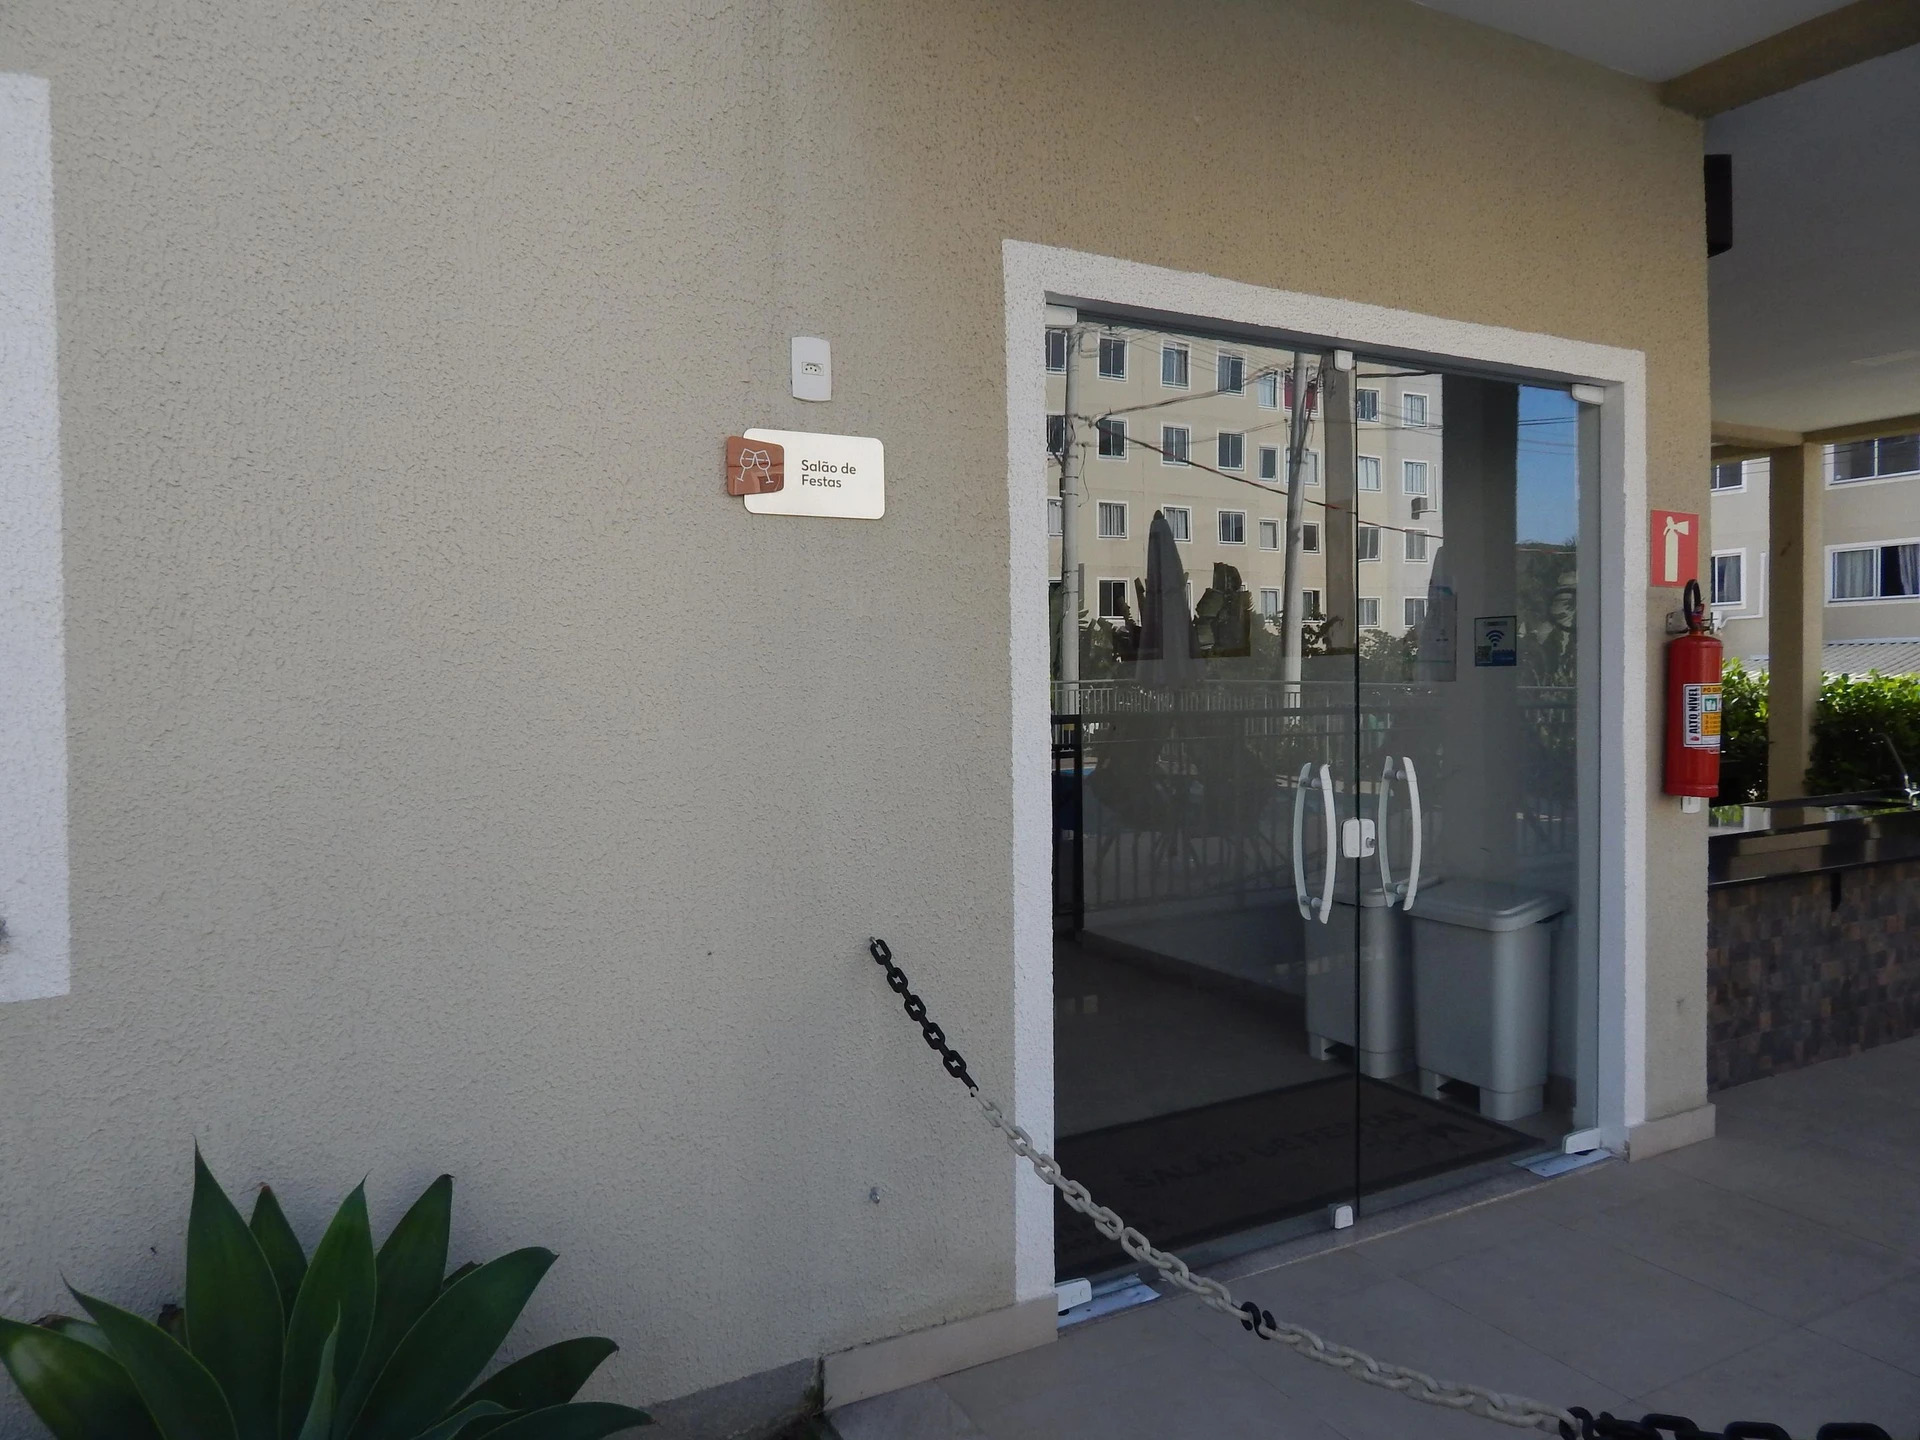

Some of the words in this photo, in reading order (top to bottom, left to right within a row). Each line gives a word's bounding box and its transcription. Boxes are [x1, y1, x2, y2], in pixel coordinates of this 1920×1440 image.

[801, 459, 837, 473] Salão
[841, 462, 857, 475] de
[801, 474, 842, 488] Festas
[1687, 688, 1697, 712] NÍVEL
[1688, 714, 1697, 734] ALTO
